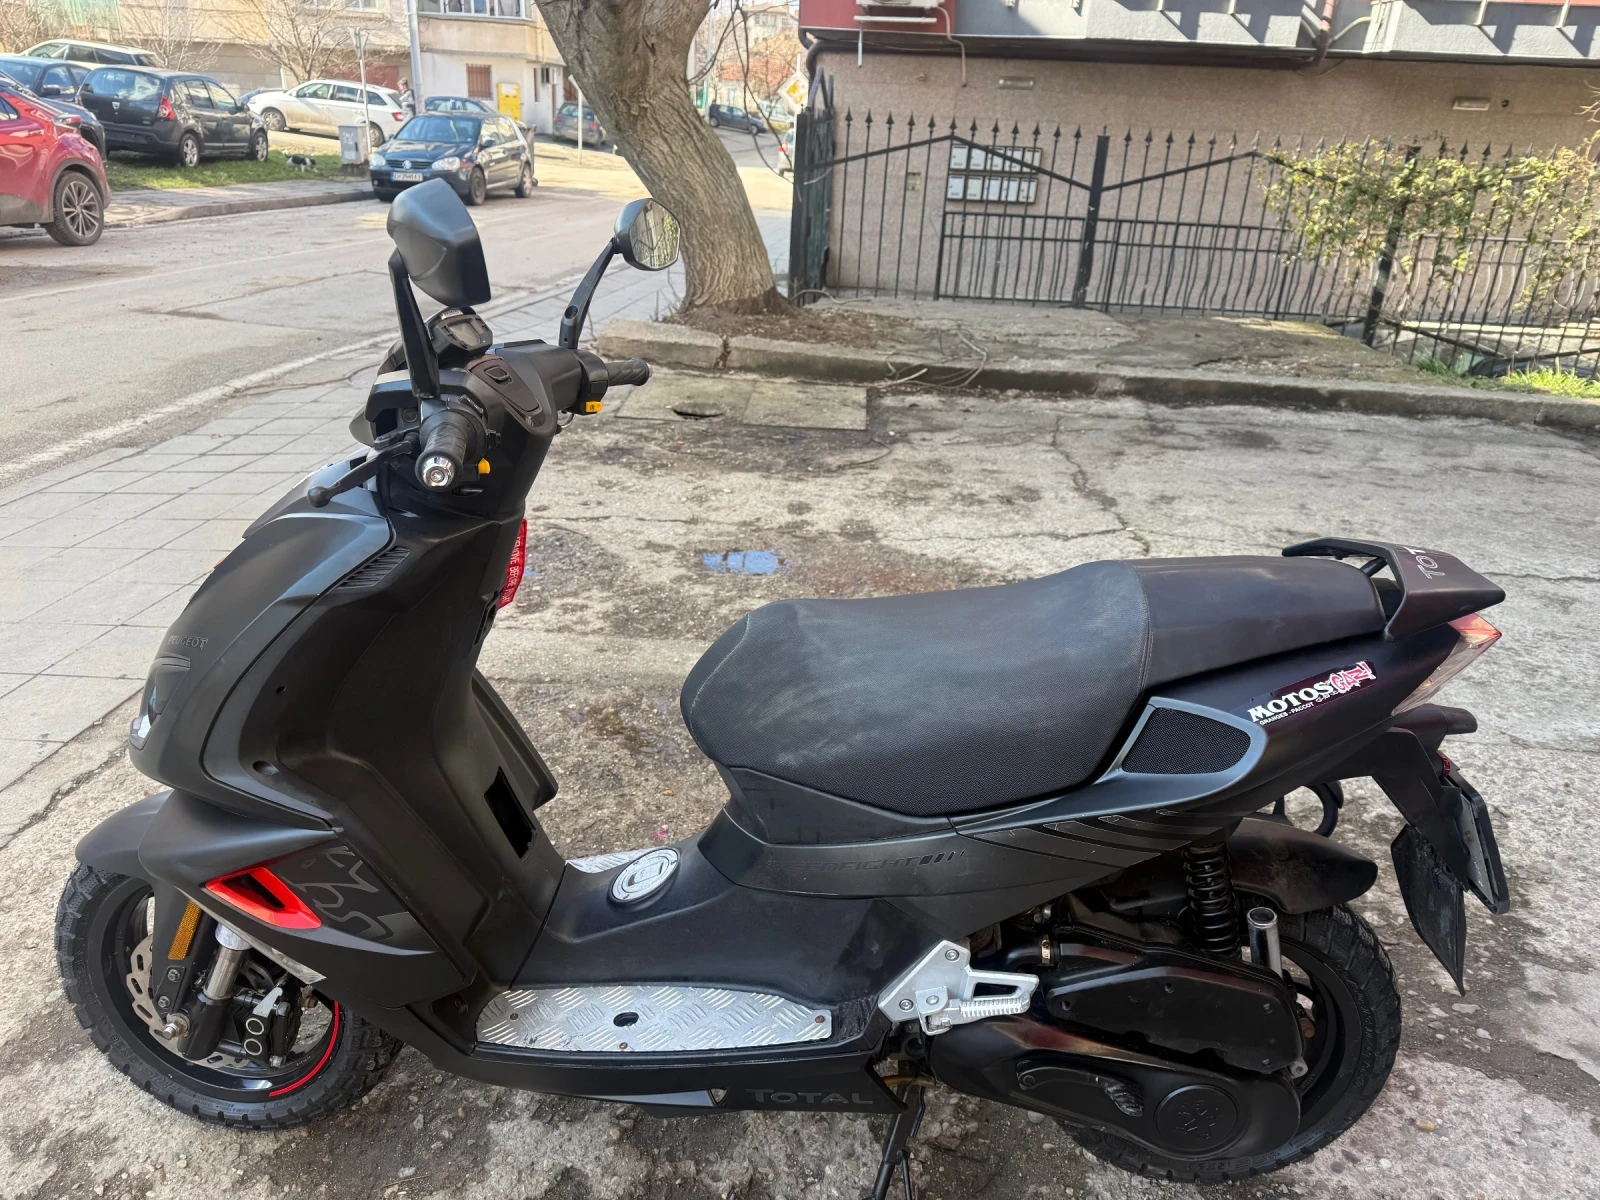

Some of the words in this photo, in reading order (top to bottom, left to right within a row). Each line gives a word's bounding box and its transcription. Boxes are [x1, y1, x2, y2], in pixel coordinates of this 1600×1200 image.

[166, 634, 209, 650] PEUGEOT
[1247, 681, 1334, 723] MOTOS
[1259, 711, 1289, 726] GRANGES
[1291, 701, 1315, 715] PACCOT
[764, 856, 920, 873] EEDFIGHT
[745, 1088, 874, 1105] TOTAL
